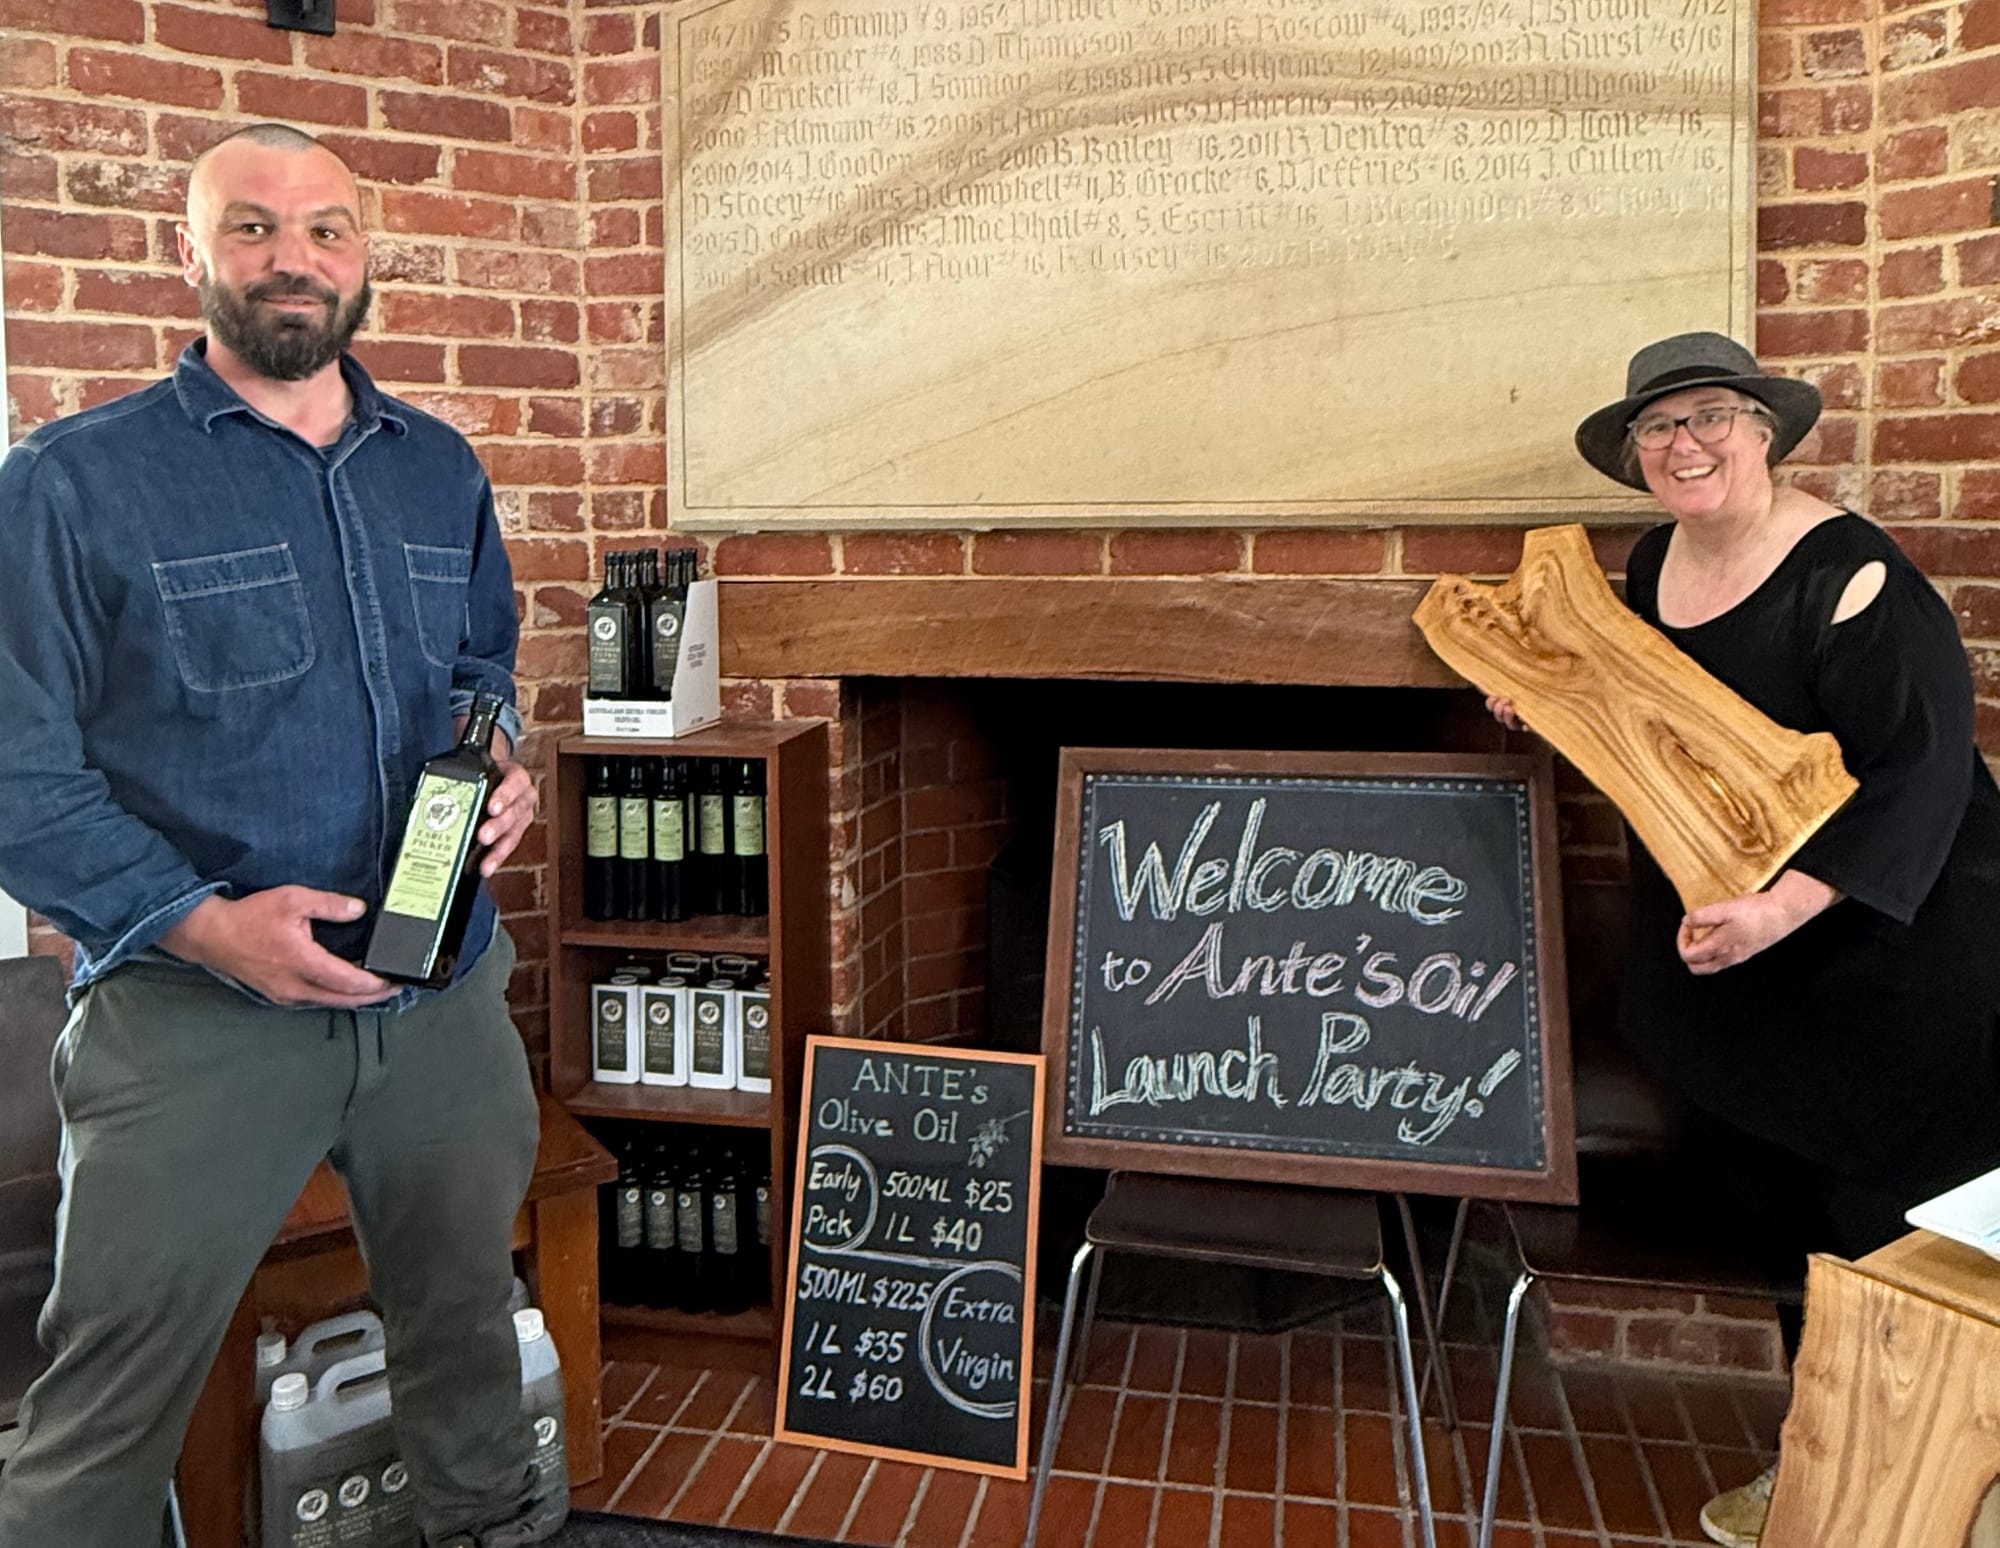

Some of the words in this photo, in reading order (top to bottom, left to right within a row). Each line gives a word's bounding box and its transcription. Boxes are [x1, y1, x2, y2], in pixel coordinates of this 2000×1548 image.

[1081, 134, 1173, 167] Bailey
[1229, 131, 1279, 159] 2011
[1481, 117, 1538, 145] 2012
[940, 174, 1062, 208] Campbell
[1474, 153, 1532, 183] 2014
[1567, 143, 1664, 175] Cullen
[1099, 797, 1468, 926] Welcome
[1101, 950, 1153, 993] to
[1143, 921, 1406, 1007] Ante's
[1408, 952, 1519, 1023] Oil
[851, 1057, 989, 1106] ANTE's
[1088, 1014, 1289, 1116] Launch
[1298, 1011, 1522, 1147] Party!
[818, 1097, 894, 1138] Olive
[913, 1106, 958, 1144] Oil
[808, 1160, 862, 1201] Early
[881, 1170, 952, 1204] 500ML
[964, 1179, 1014, 1213] $25
[804, 1204, 855, 1240] Pick
[931, 1217, 984, 1253] $40
[798, 1262, 868, 1306] 500ML
[942, 1286, 1016, 1325] Extra
[854, 1329, 907, 1366] $35
[936, 1337, 1015, 1391] Virgin
[799, 1363, 838, 1401] 2L
[849, 1370, 903, 1404] $60
